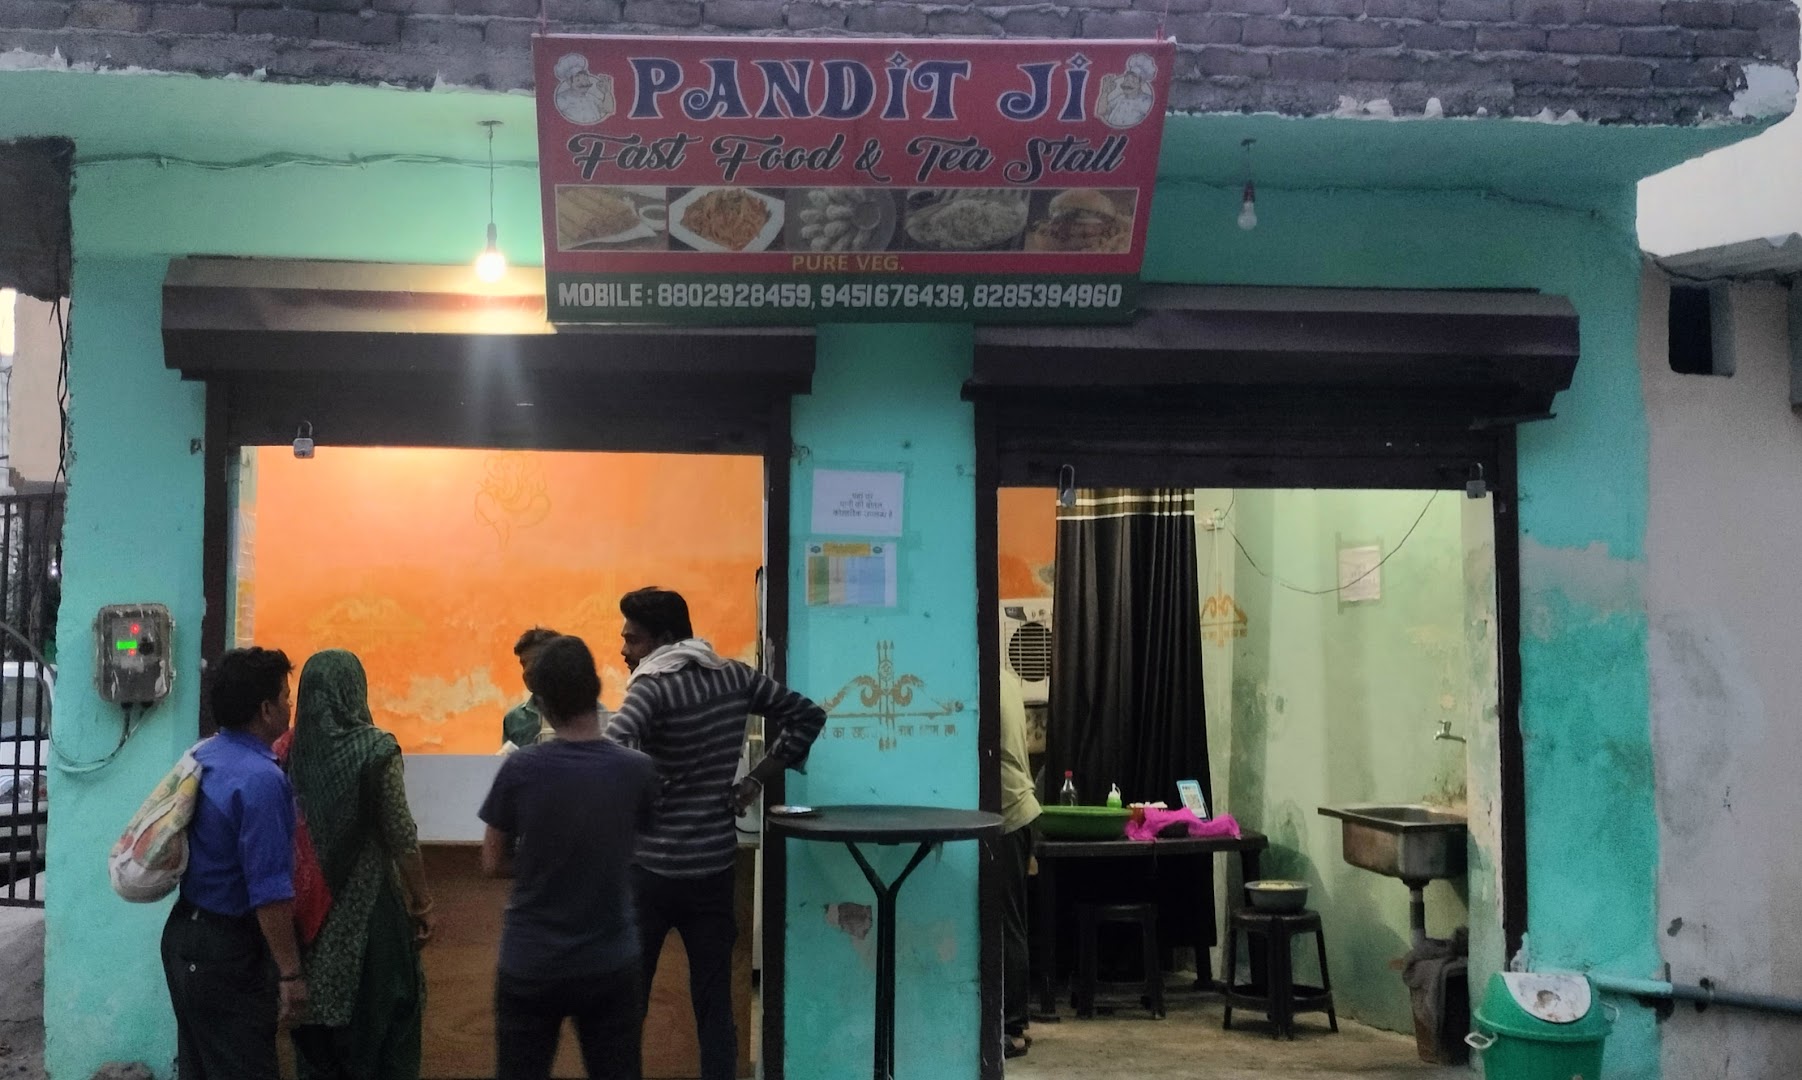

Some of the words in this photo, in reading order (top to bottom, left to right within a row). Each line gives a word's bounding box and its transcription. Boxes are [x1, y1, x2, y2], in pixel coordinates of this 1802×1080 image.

[567, 132, 702, 181] Fast
[711, 133, 846, 182] Food
[854, 139, 891, 182] &
[907, 135, 995, 183] Tea
[1003, 134, 1129, 184] Stall
[792, 255, 848, 271] PURE
[856, 255, 905, 271] VEG.
[973, 284, 1122, 309] 8285394960
